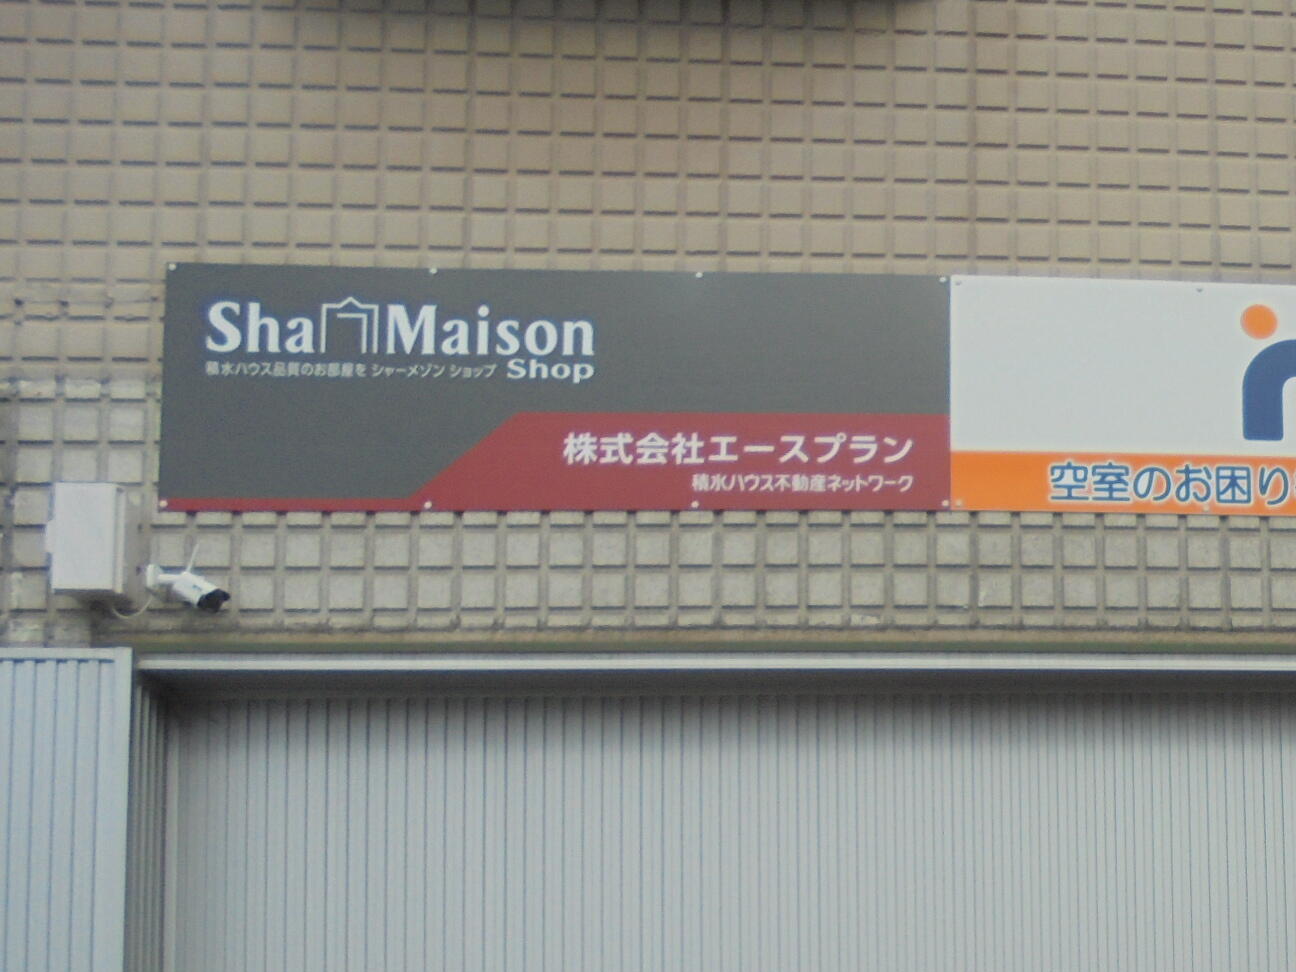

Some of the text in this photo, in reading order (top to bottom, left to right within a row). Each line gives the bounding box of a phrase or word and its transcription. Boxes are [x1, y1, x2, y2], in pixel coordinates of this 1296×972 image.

[506, 357, 595, 384] Shop
[562, 431, 913, 466] 株式会社エースプラン
[692, 472, 914, 493] 積水ハウス不動産ネットワーク
